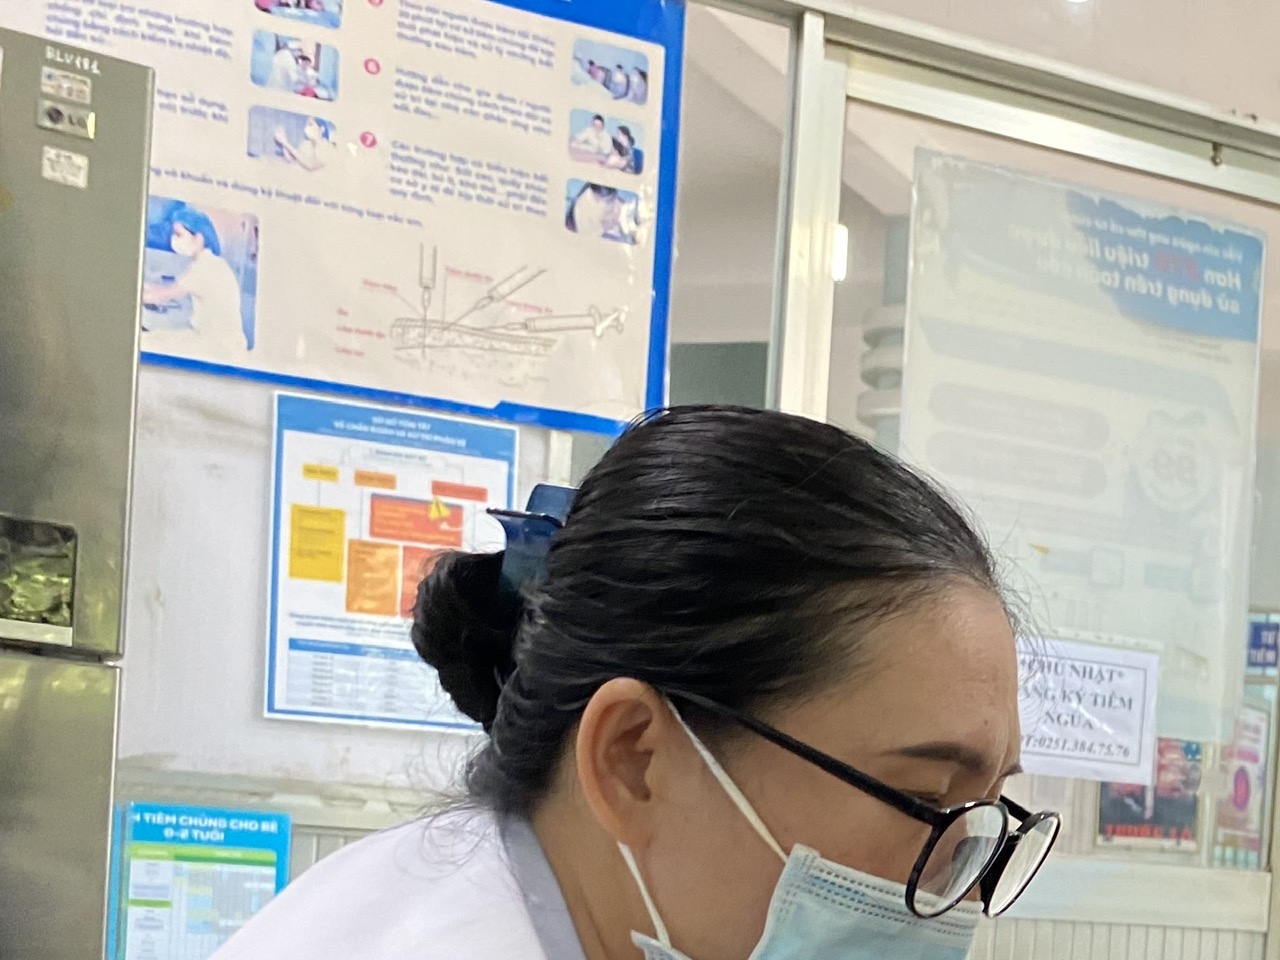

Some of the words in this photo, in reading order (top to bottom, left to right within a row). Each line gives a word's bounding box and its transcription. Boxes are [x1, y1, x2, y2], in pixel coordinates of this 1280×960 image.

[1091, 689, 1133, 711] TIÊM
[1021, 735, 1130, 758] T:0251.384.75.76
[143, 811, 177, 825] TIÊM
[179, 812, 227, 829] CHỦNG
[229, 818, 259, 831] CHO
